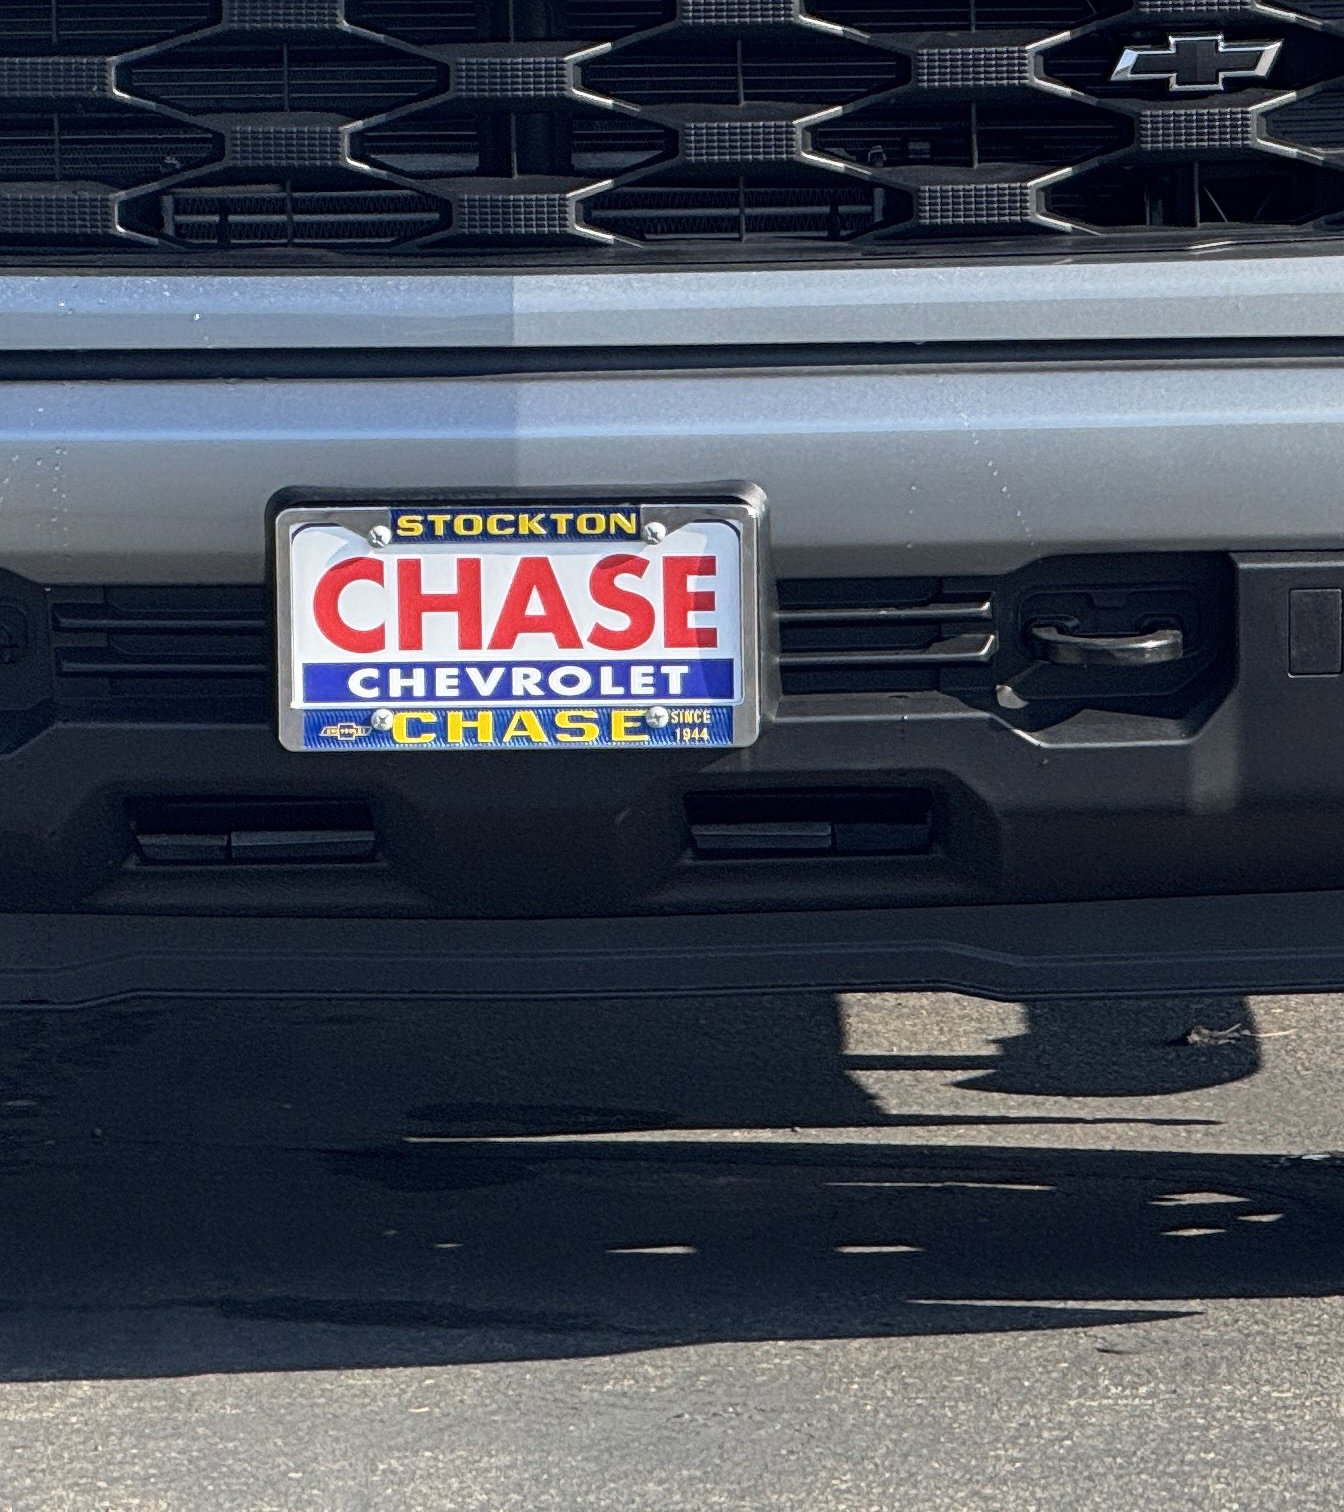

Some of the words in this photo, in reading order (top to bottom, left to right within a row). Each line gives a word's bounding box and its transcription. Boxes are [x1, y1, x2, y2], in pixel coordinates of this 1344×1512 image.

[396, 511, 638, 538] STOCKTON
[312, 553, 719, 654] CHASE
[347, 665, 690, 698] CHEVROLET
[392, 709, 650, 745] CHASE
[670, 709, 712, 724] SINCE
